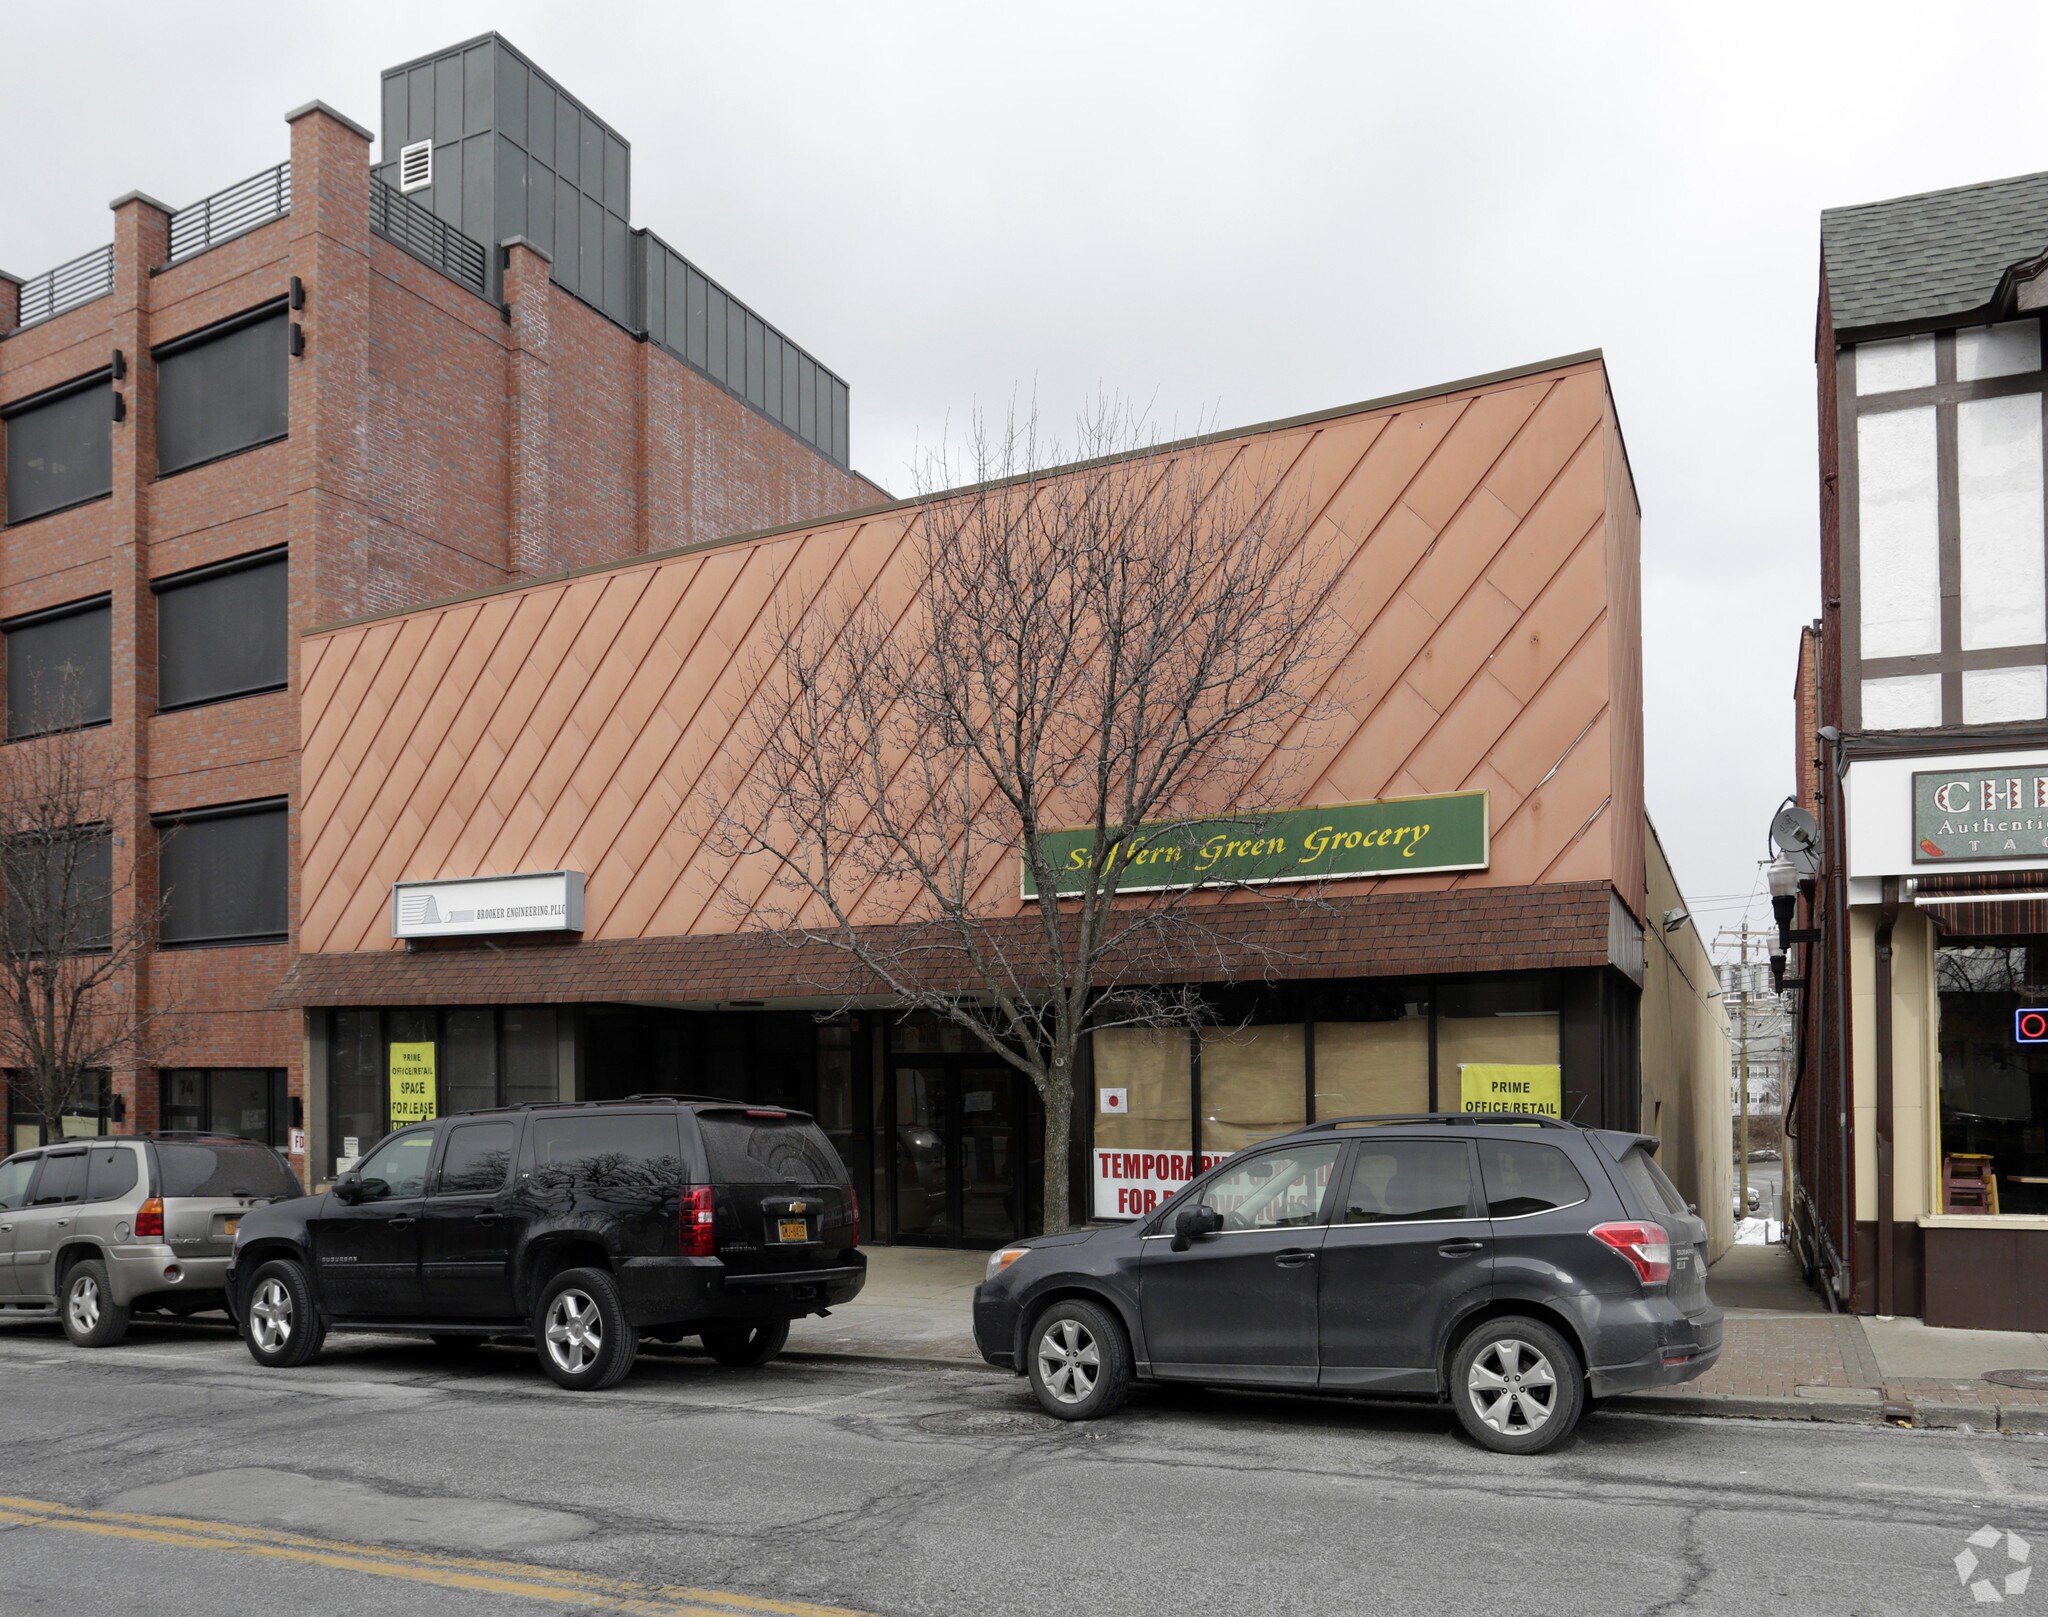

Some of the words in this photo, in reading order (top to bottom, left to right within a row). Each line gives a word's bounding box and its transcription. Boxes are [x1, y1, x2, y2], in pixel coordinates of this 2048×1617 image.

[1937, 815, 2048, 835] Authenti
[1194, 835, 1286, 871] Green
[1298, 824, 1430, 863] Grocery
[477, 908, 505, 920] BROOKER
[550, 903, 566, 916] PLLC
[403, 1053, 421, 1062] PRIME
[392, 1066, 433, 1076] OFFICE/RETAIL
[400, 1081, 425, 1095] SPACE
[1491, 1081, 1531, 1093] PRIME
[392, 1101, 408, 1115] FOR
[409, 1101, 434, 1115] LEASE
[1465, 1101, 1557, 1115] OFFICE/RETAIL
[1118, 1188, 1157, 1215] FOR
